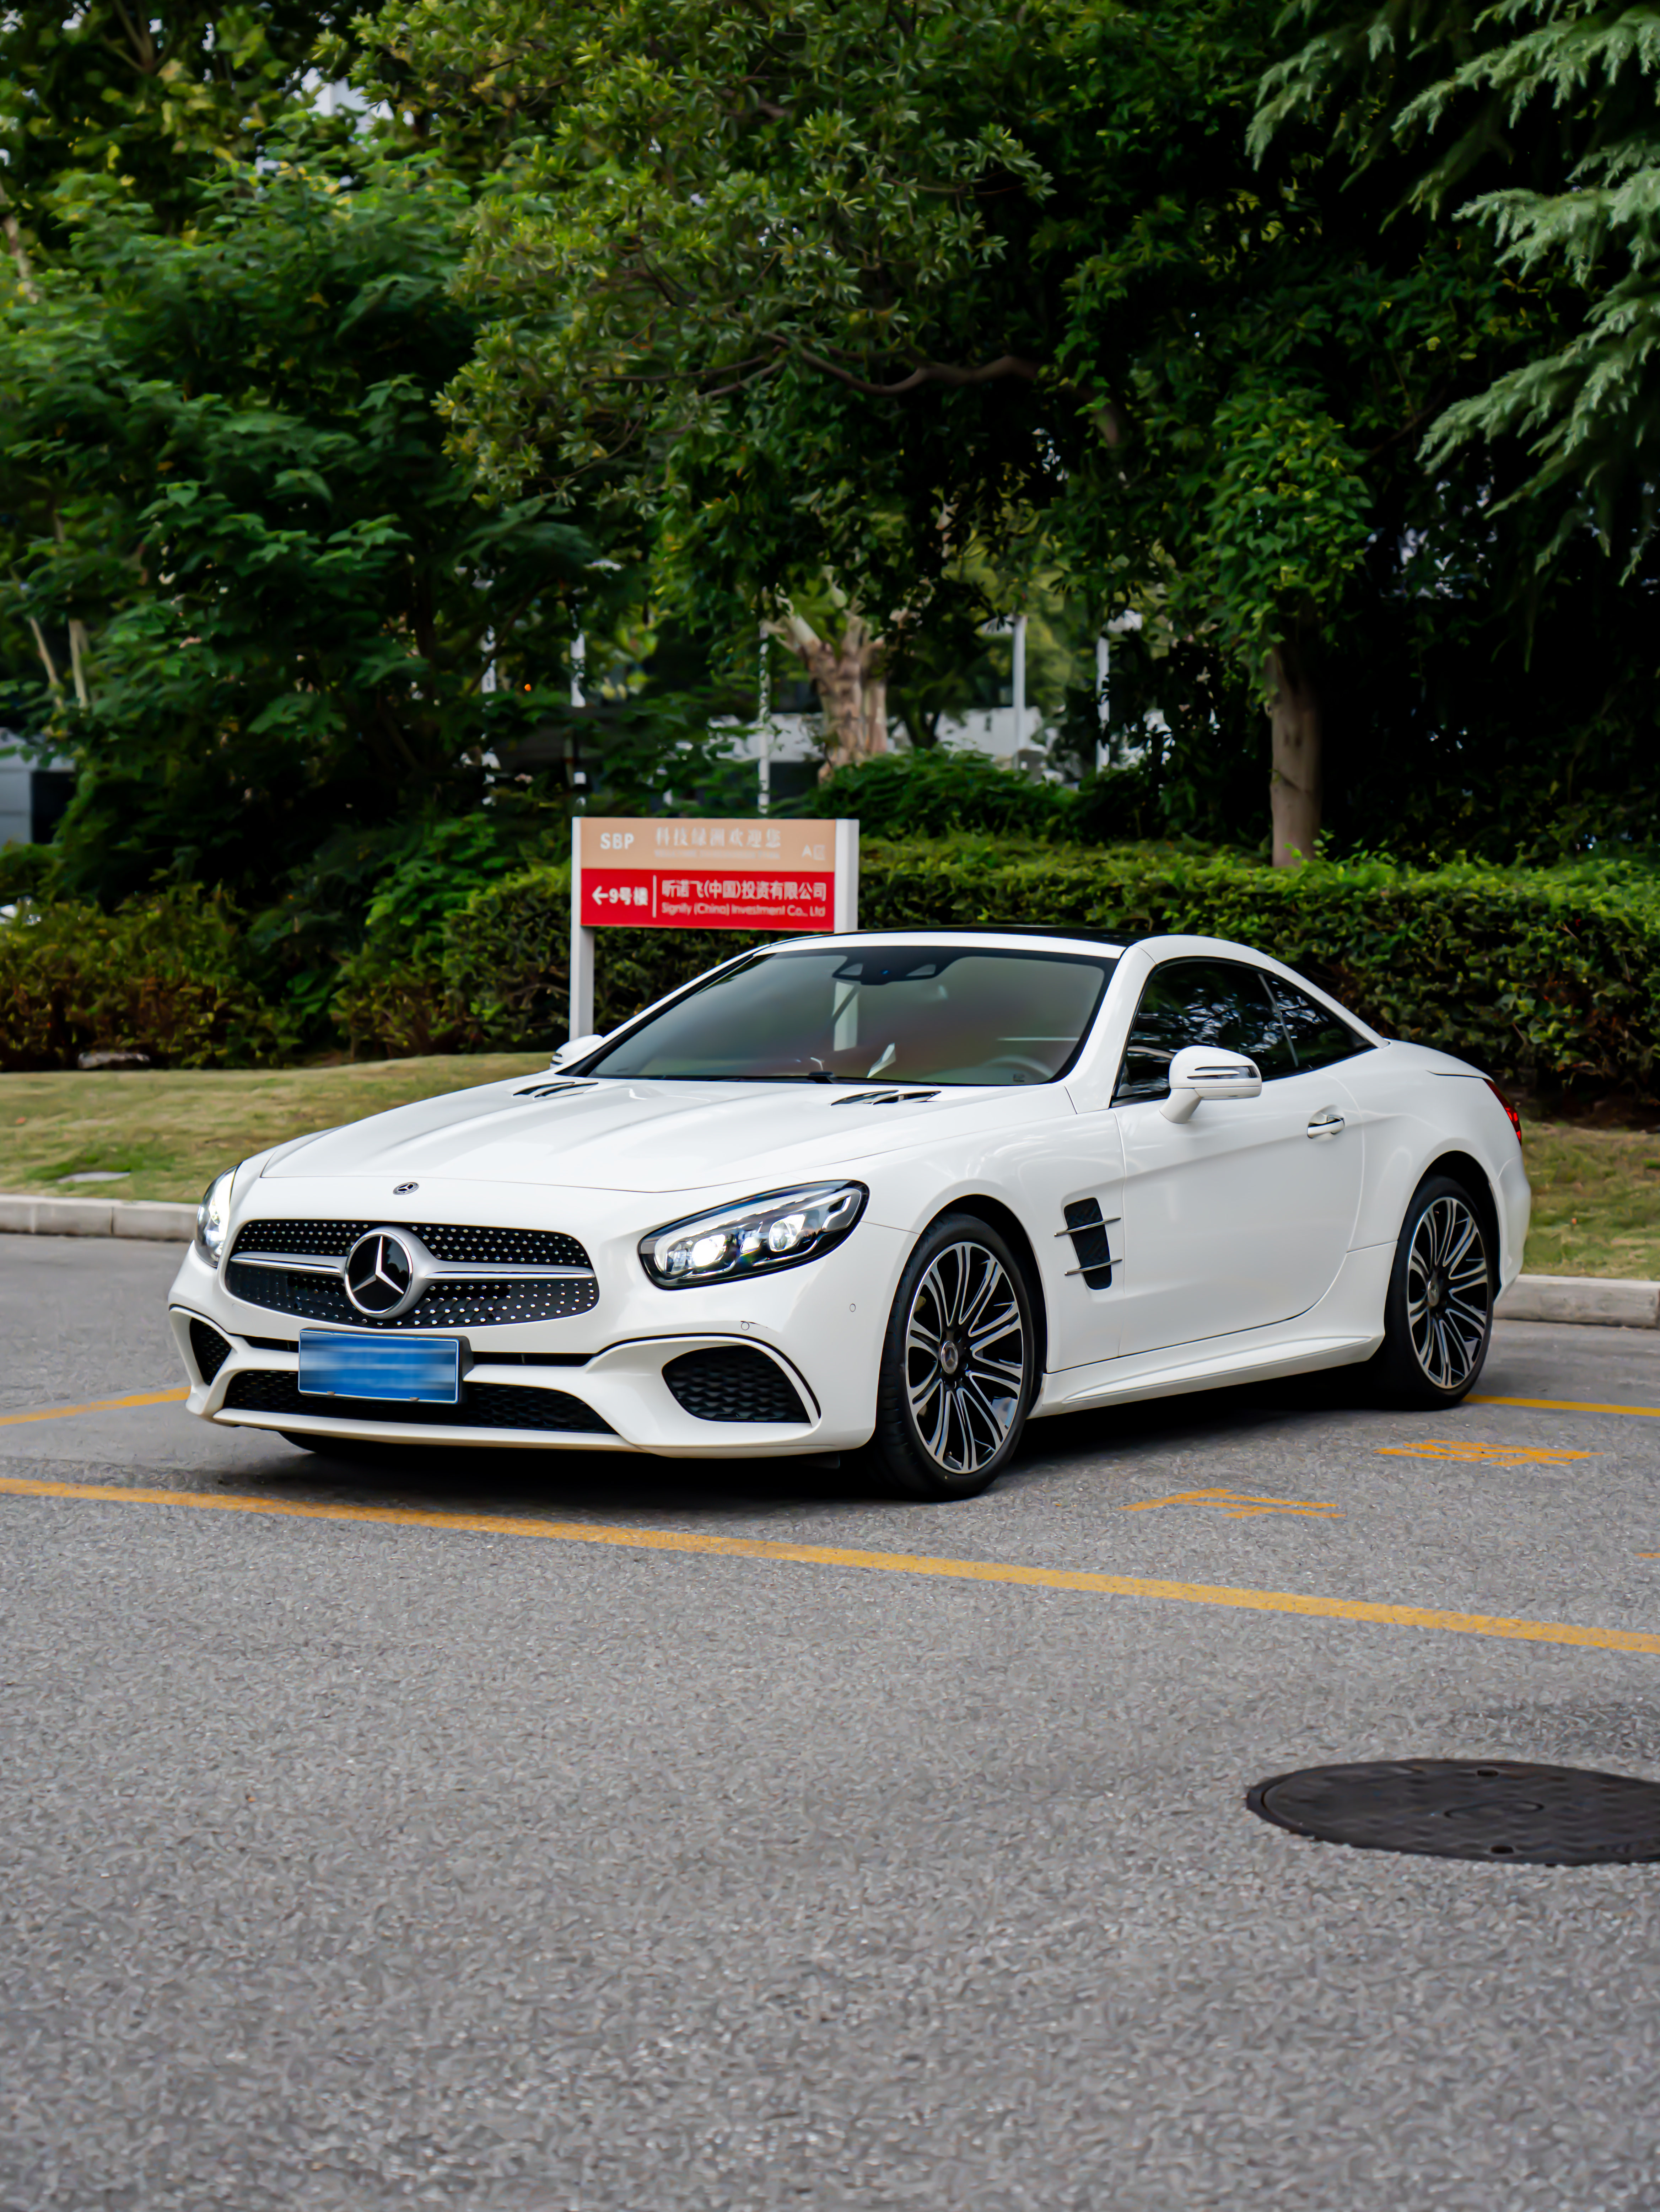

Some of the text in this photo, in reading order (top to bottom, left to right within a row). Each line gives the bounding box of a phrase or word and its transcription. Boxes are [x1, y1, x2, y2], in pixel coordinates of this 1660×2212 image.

[600, 832, 634, 850] SBP
[609, 886, 648, 906] 9号楼
[694, 902, 730, 916] (China)
